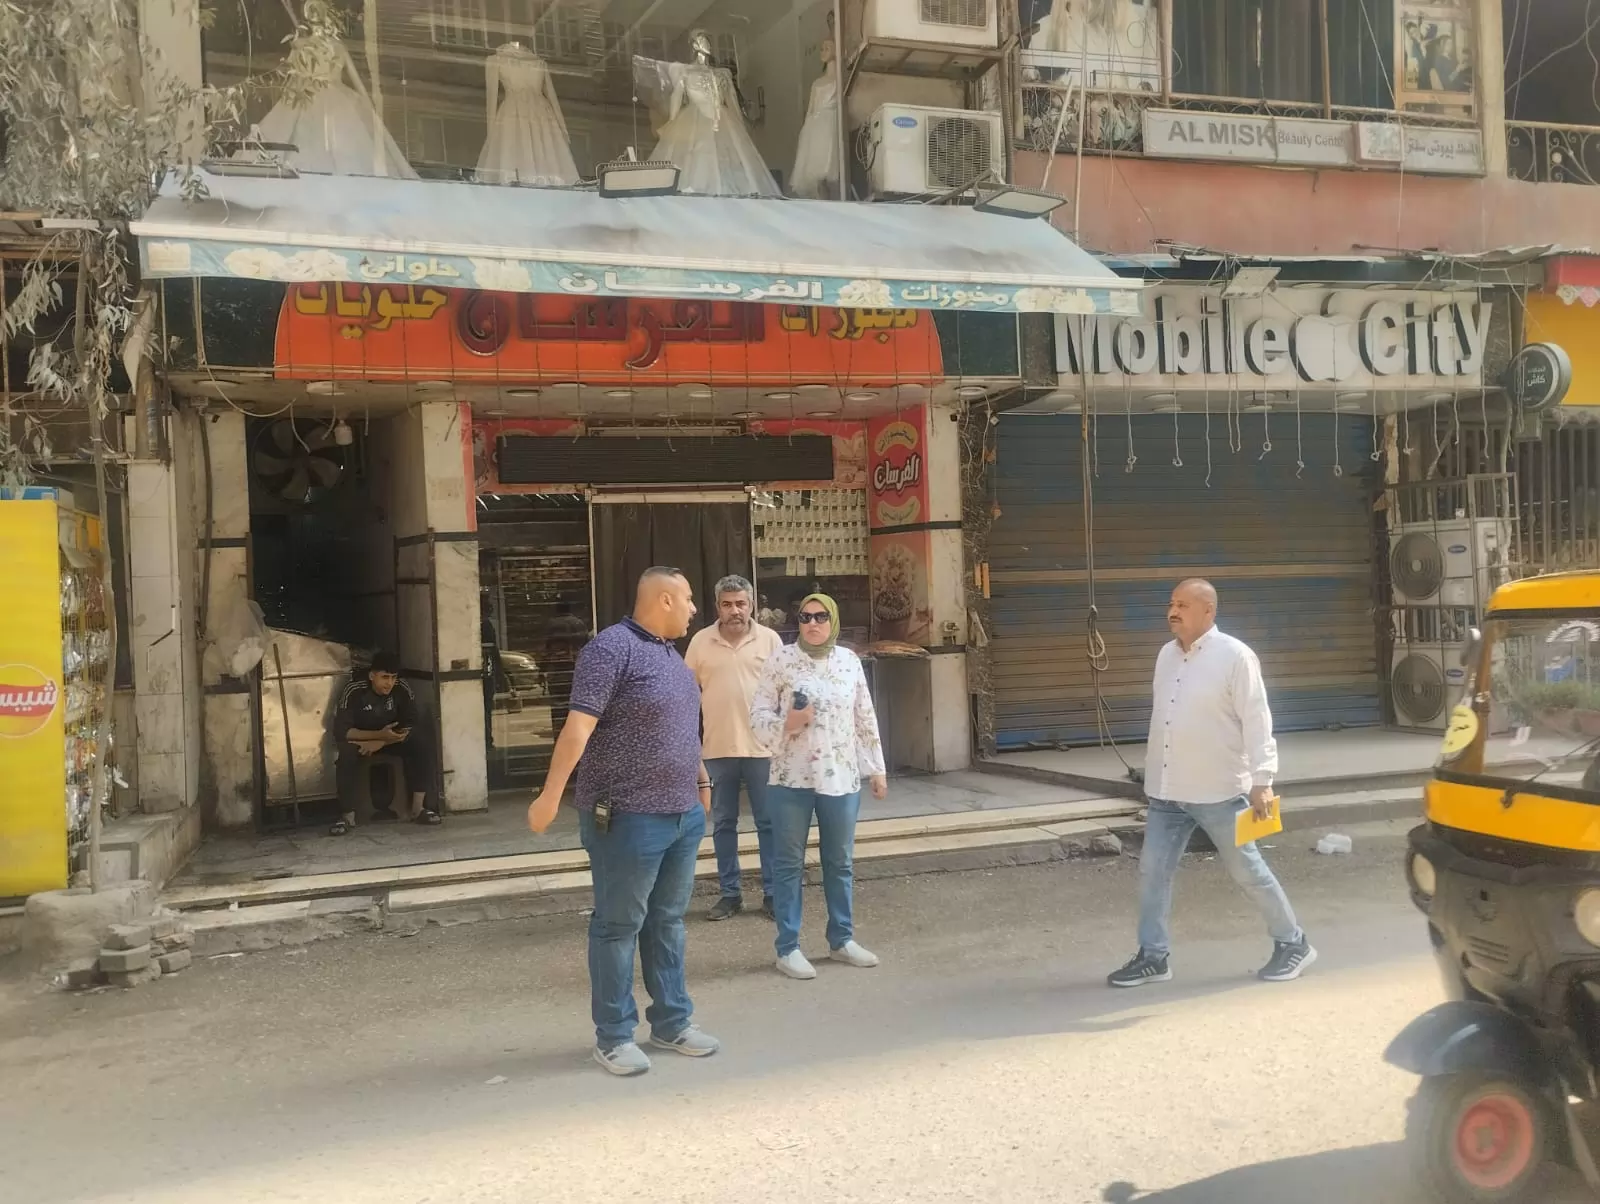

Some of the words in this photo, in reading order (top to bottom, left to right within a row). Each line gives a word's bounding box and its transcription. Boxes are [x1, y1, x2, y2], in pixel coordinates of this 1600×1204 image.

[1167, 120, 1204, 143] AL
[1208, 122, 1275, 147] MISK
[1278, 129, 1312, 149] Beauty
[557, 271, 825, 301] الفرسان
[901, 285, 1010, 308] مخبوزات
[1053, 296, 1289, 376] Mobile
[1358, 300, 1493, 377] City
[873, 452, 921, 492] الفرسان
